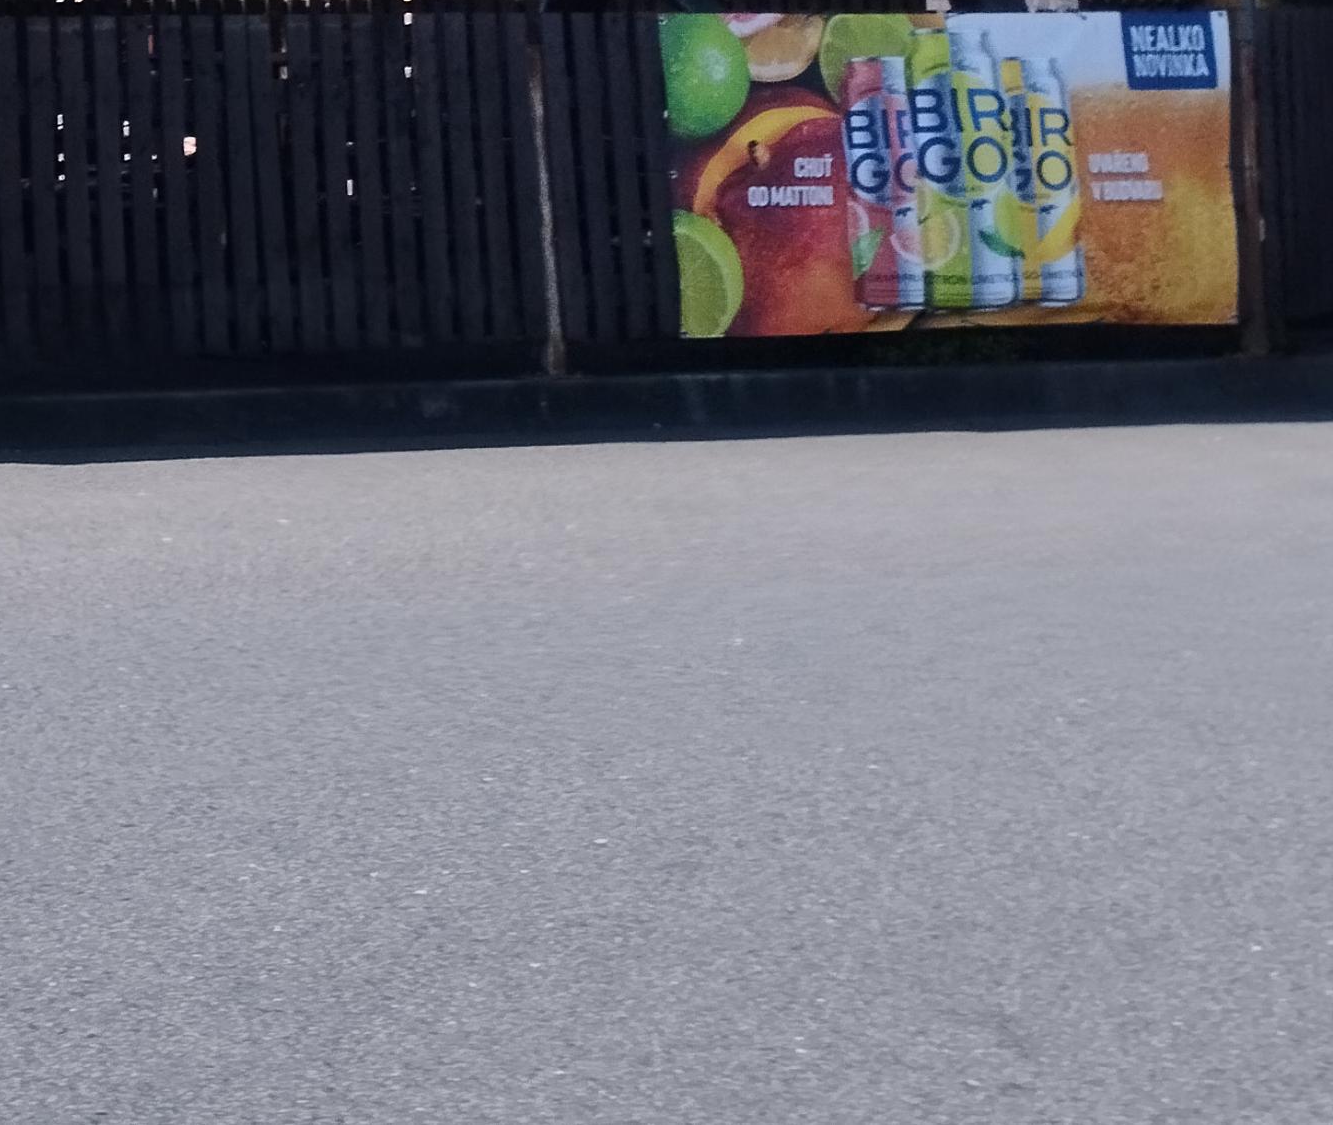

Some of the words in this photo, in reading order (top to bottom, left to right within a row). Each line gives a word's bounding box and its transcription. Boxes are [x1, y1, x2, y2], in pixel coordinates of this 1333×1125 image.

[1129, 25, 1206, 51] NEALKO
[911, 88, 1011, 134] BIR
[918, 136, 1009, 185] GO
